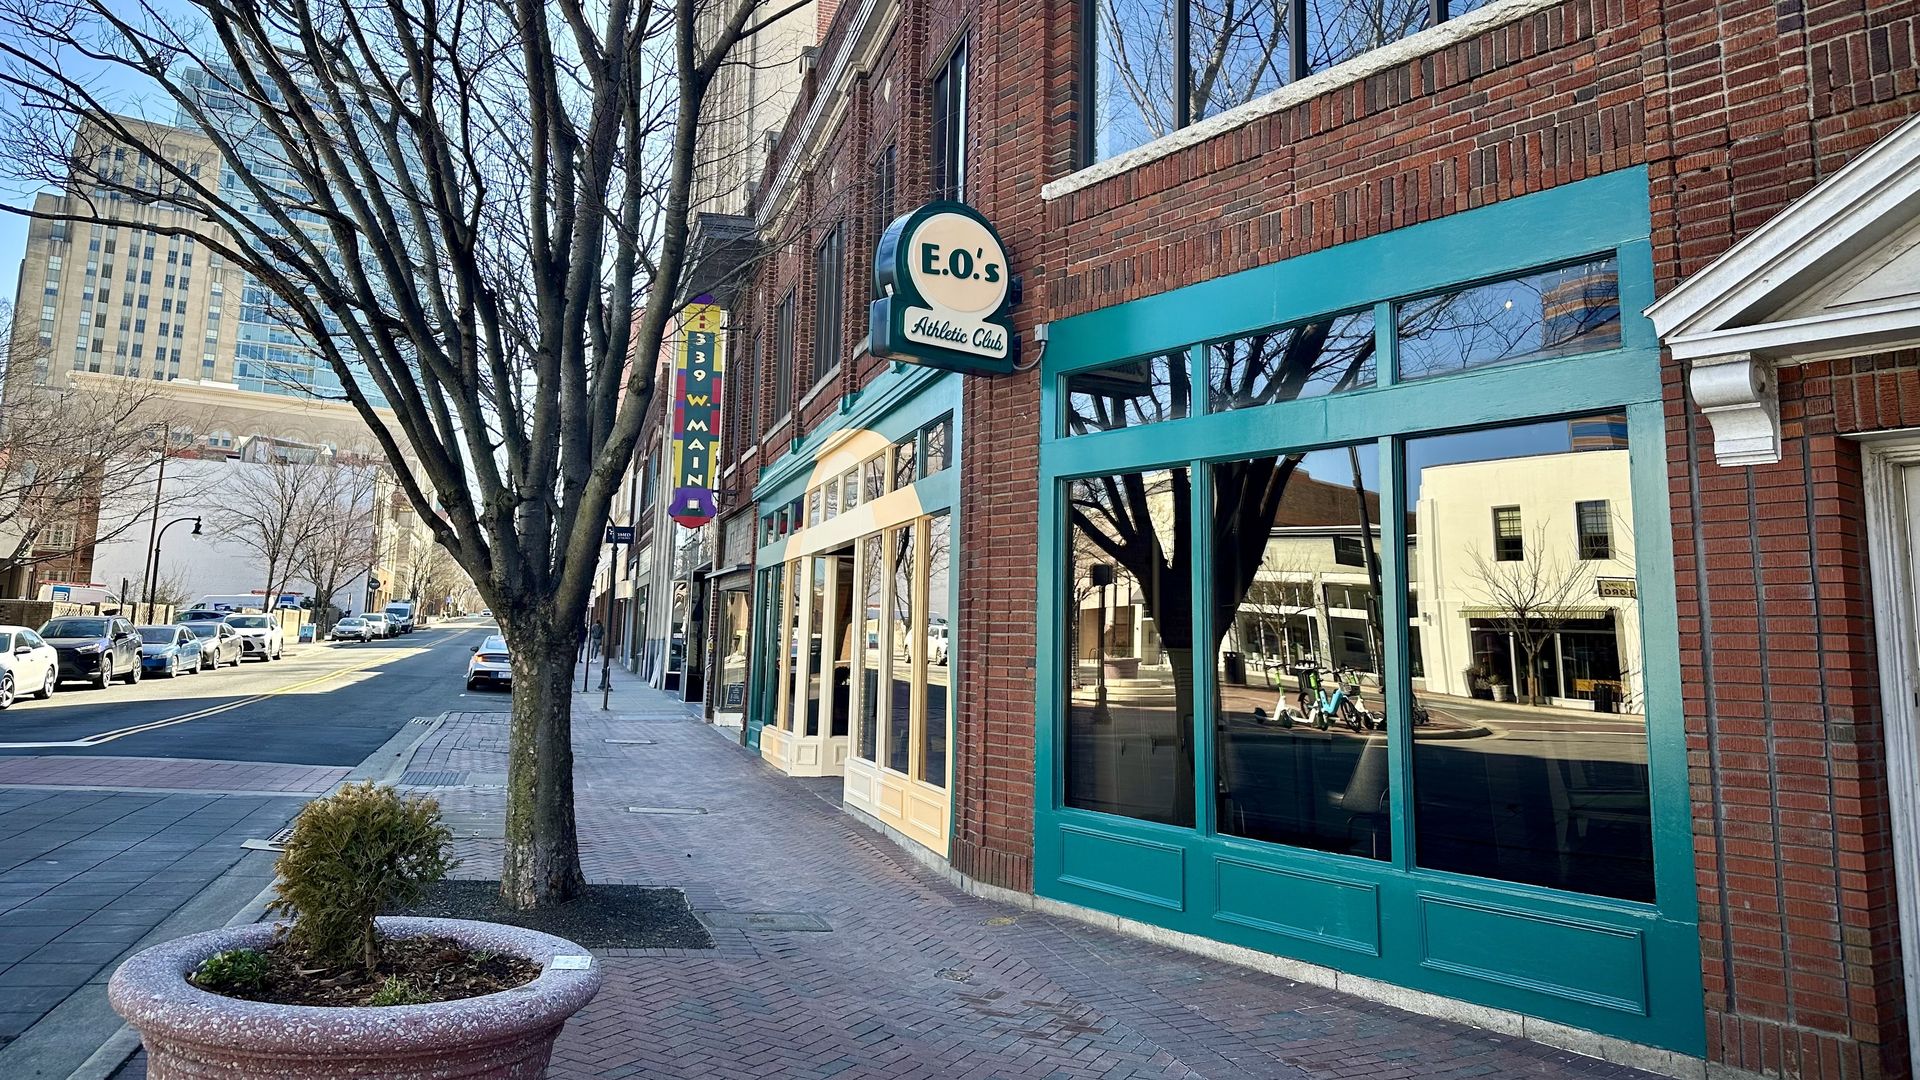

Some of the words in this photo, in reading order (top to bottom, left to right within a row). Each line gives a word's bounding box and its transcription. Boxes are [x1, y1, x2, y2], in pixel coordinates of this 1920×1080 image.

[921, 242, 1000, 283] E.O.'s
[911, 316, 968, 344] Athletic
[972, 327, 1003, 351] Club
[693, 333, 707, 381] 339
[686, 393, 711, 407] W.
[686, 419, 709, 486] MAIN
